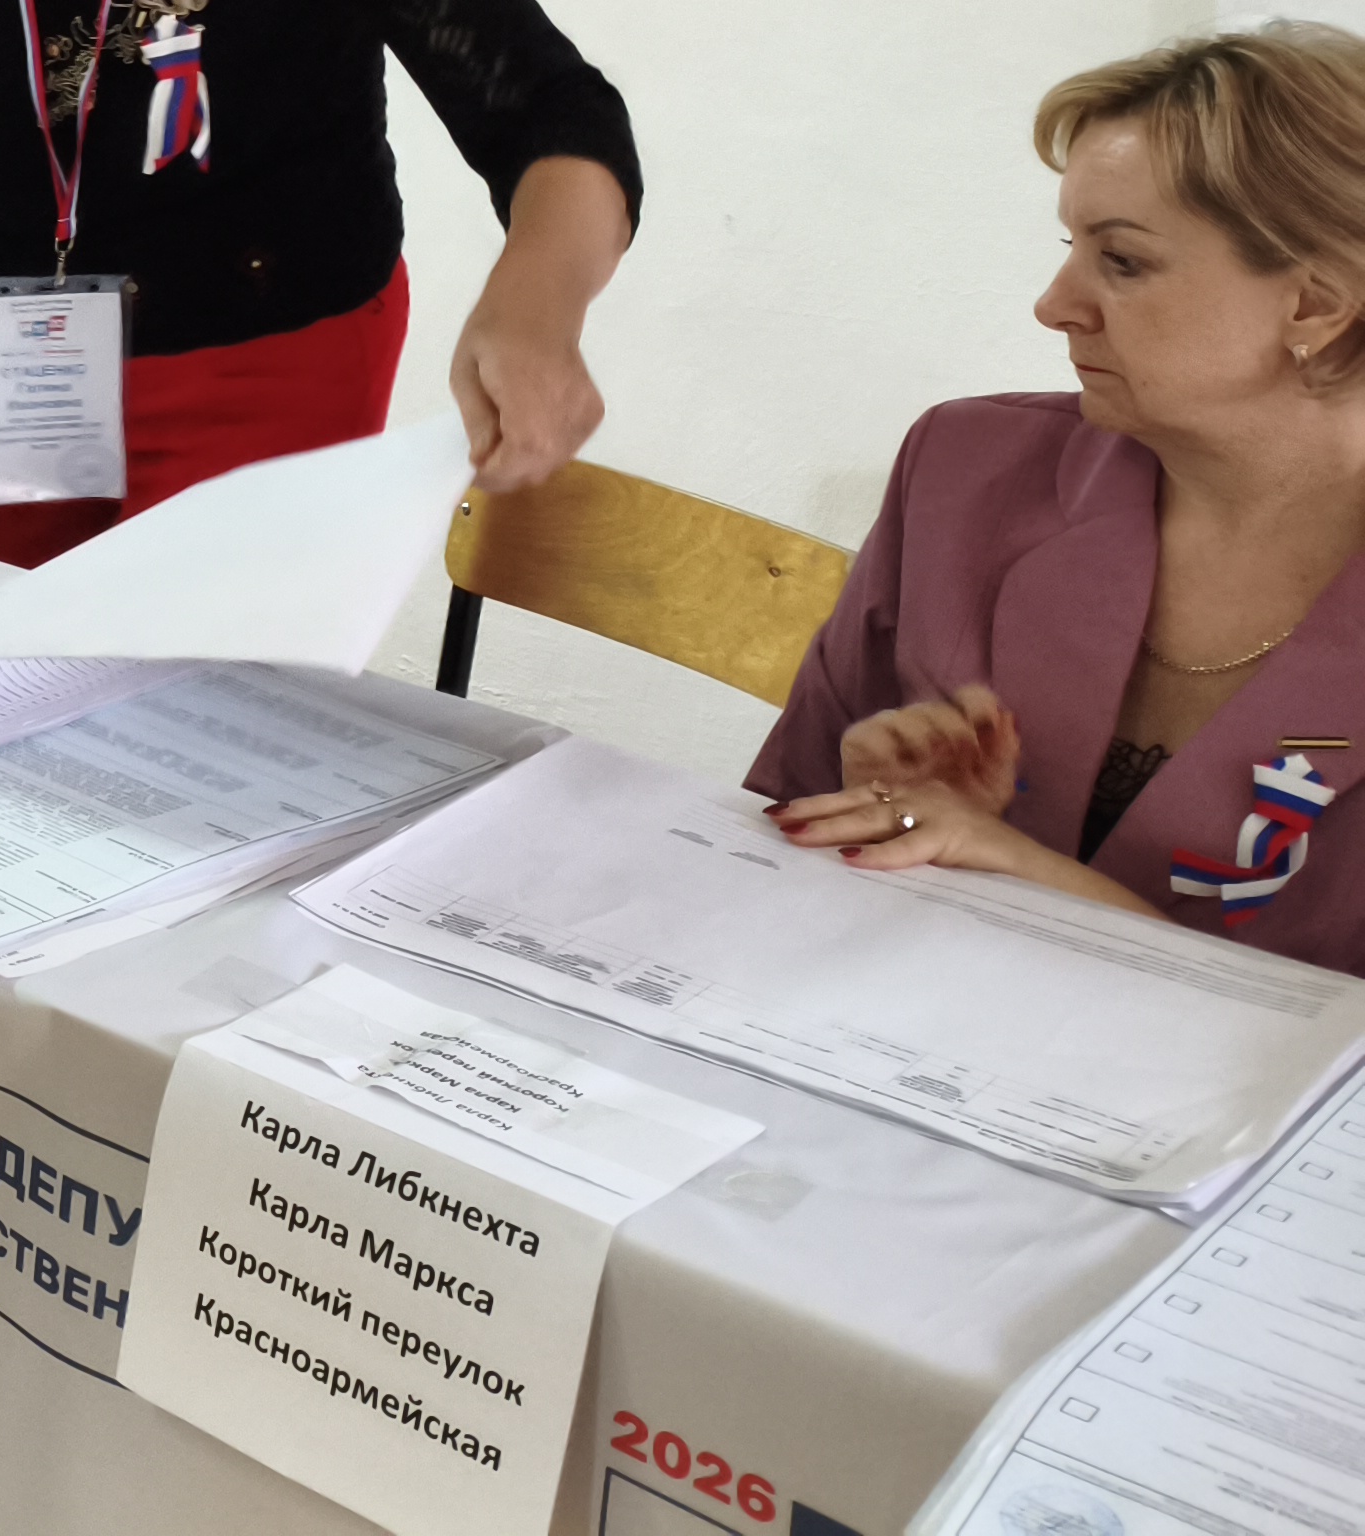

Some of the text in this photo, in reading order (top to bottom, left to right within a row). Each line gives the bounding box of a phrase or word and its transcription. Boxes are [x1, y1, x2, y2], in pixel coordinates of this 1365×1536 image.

[456, 1102, 514, 1132] Карла
[464, 1086, 523, 1114] Карла
[477, 1071, 570, 1113] Короткий
[239, 1100, 542, 1258] Карла Либкнехта
[248, 1177, 495, 1317] Карла Маркса
[198, 1225, 526, 1408] Короткий переулок
[193, 1292, 503, 1473] Красноармейская
[610, 1410, 777, 1523] 2026
